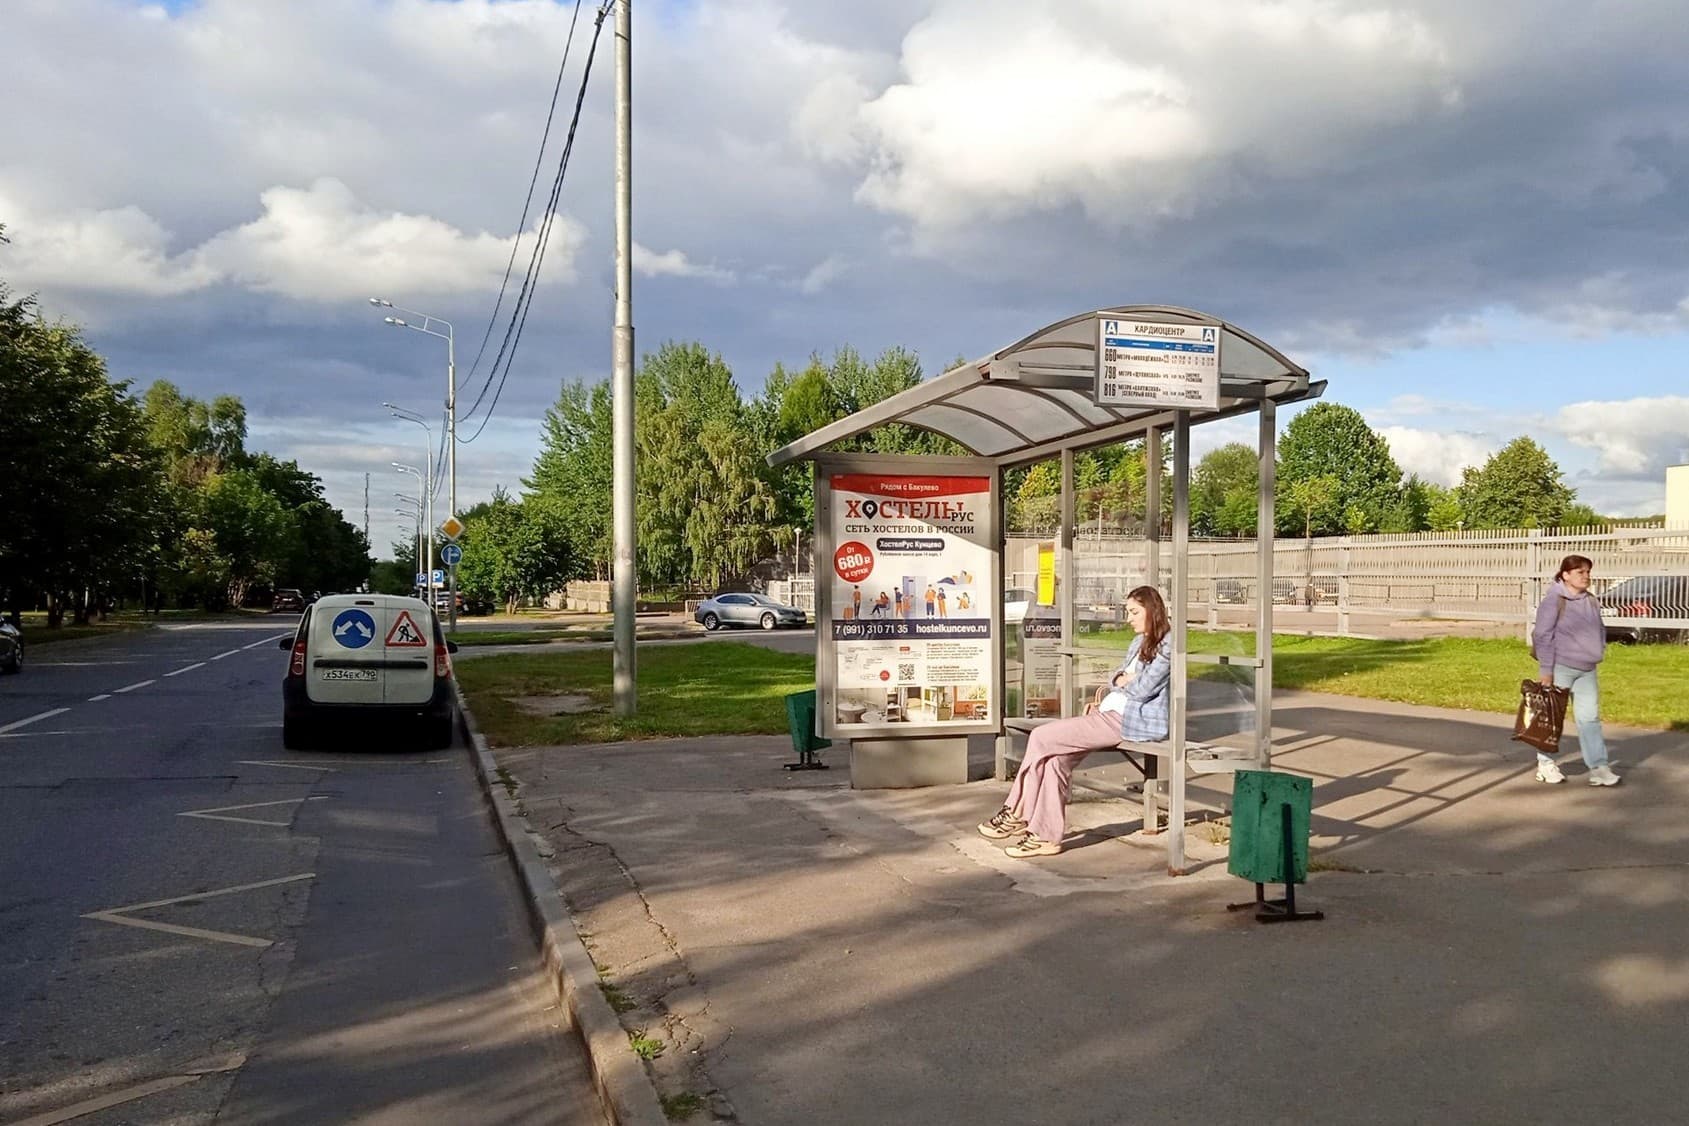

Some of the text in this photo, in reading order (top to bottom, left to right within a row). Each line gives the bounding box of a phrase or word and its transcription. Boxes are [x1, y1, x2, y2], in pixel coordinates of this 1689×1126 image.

[1134, 325, 1184, 336] КАРДИОЦЕНТР
[881, 482, 902, 490] Рядом
[952, 512, 974, 522] РУС
[846, 524, 870, 533] СЕТЬ
[872, 525, 924, 534] ХОСТЕЛОВ
[915, 540, 942, 549] Кунцево
[834, 624, 908, 636] 7 (991) 310 71 35
[916, 624, 987, 634] hostelkuncevo.ru
